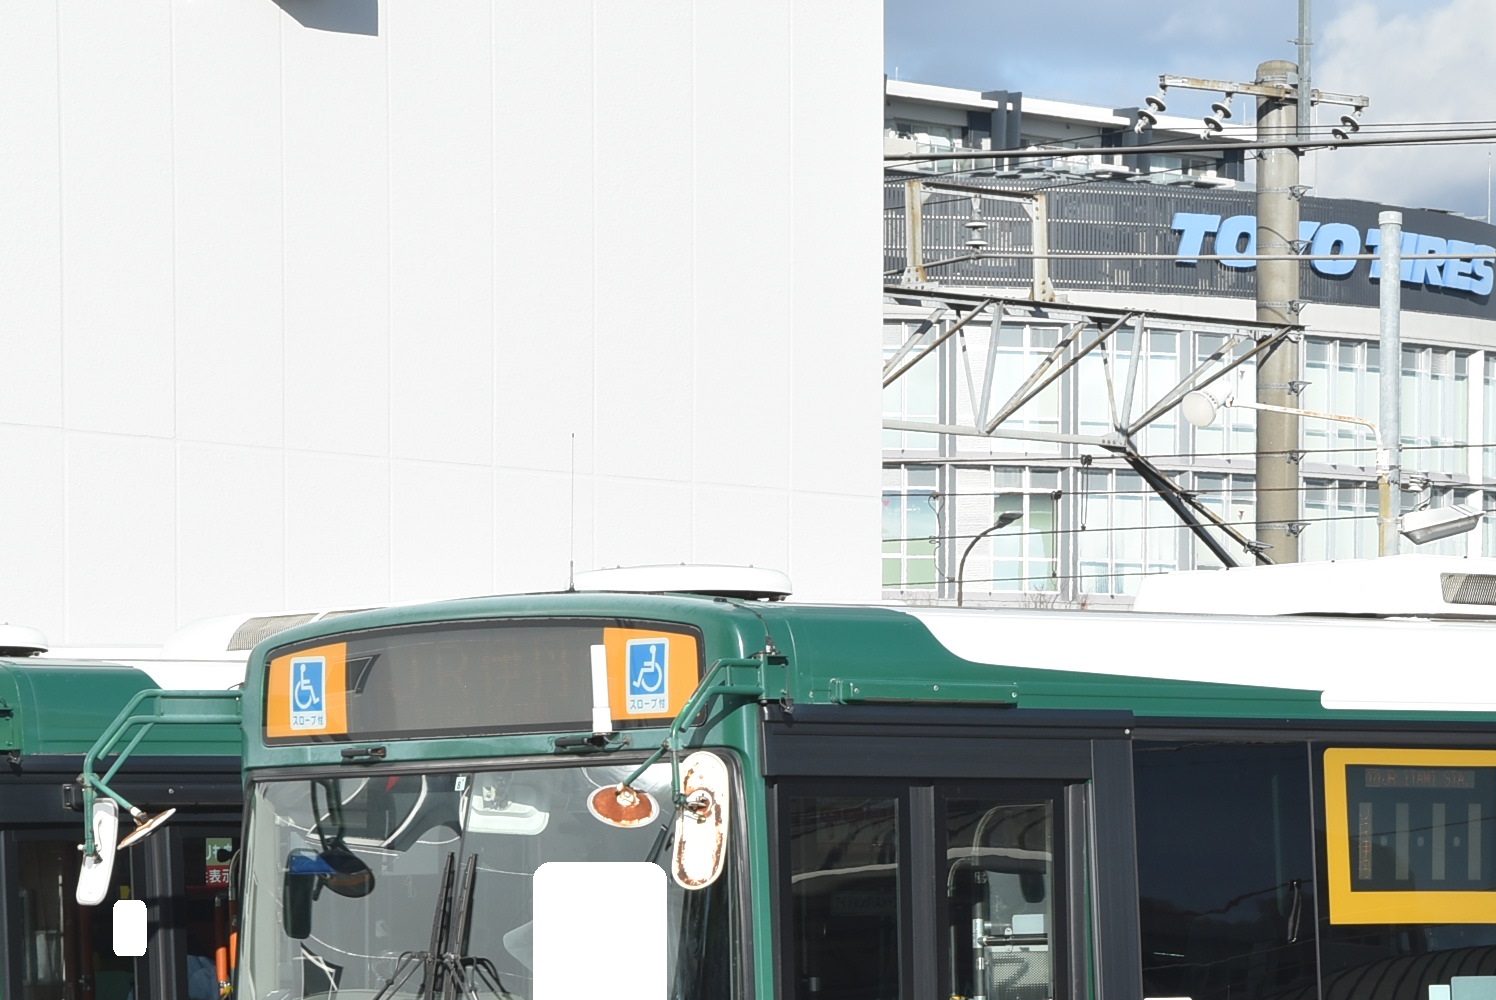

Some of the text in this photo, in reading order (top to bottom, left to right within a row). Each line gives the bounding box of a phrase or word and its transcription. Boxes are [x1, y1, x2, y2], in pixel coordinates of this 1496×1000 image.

[630, 698, 665, 710] スロープ付
[293, 715, 324, 726] スロープ付
